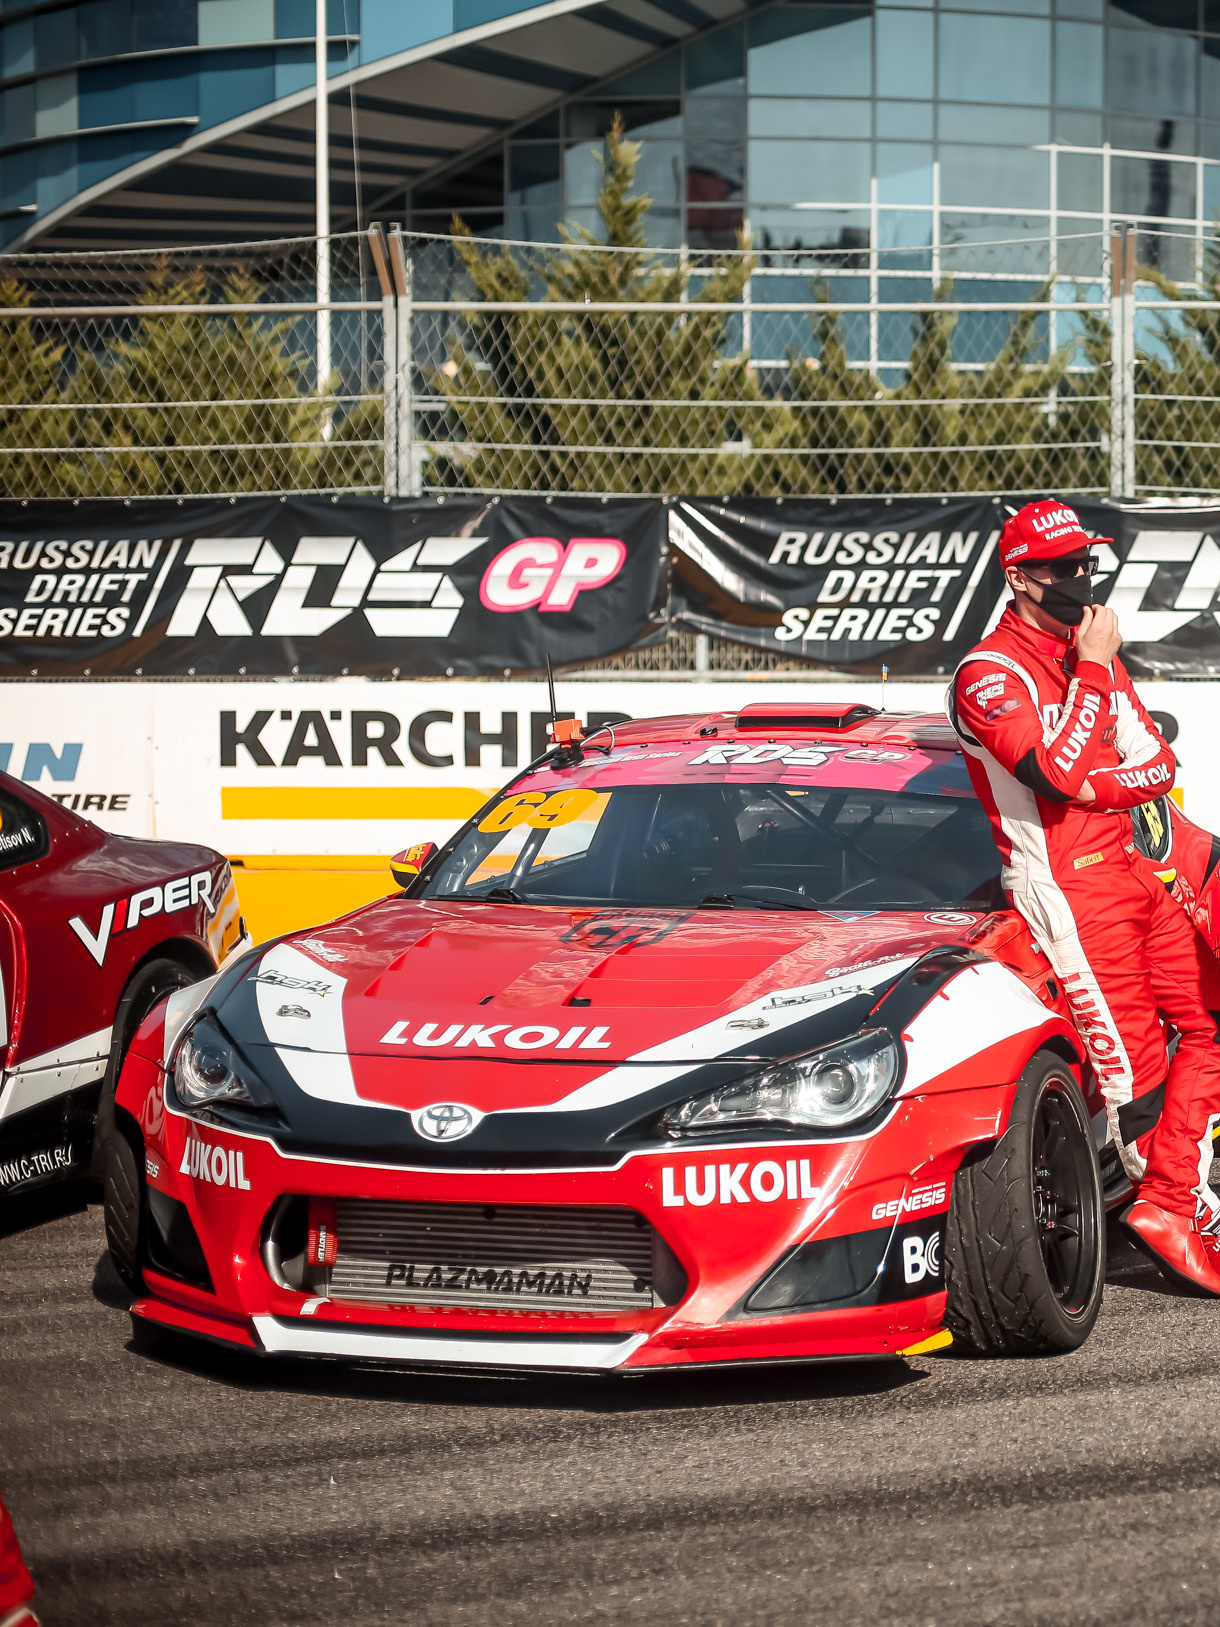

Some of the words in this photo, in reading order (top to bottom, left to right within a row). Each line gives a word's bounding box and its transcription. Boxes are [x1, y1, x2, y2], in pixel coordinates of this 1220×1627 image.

[0, 539, 163, 569] RUSSIAN
[768, 530, 980, 565] RUSSIAN
[24, 573, 149, 603] DRIFT
[165, 536, 490, 637] RDS
[482, 539, 624, 609] GP
[816, 569, 962, 603] DRIFT
[0, 606, 131, 638] SERIES
[774, 607, 941, 642] SERIES
[966, 672, 1007, 696] GENESIS
[219, 708, 634, 767] KÄRCHE
[1054, 693, 1100, 773] LUKOIL
[645, 750, 684, 760] Series
[686, 744, 848, 766] RDS
[844, 749, 909, 763] GP
[52, 794, 131, 811] TIRE
[477, 789, 598, 833] 69
[67, 870, 216, 967] VIPER
[378, 1020, 613, 1050] LUKOIL
[179, 1136, 252, 1191] LUKOIL
[662, 1159, 821, 1207] LUKOIL
[871, 1188, 946, 1220] GENESIS
[318, 1224, 327, 1263] SANDTLER
[385, 1263, 593, 1296] PLAZMAMAN
